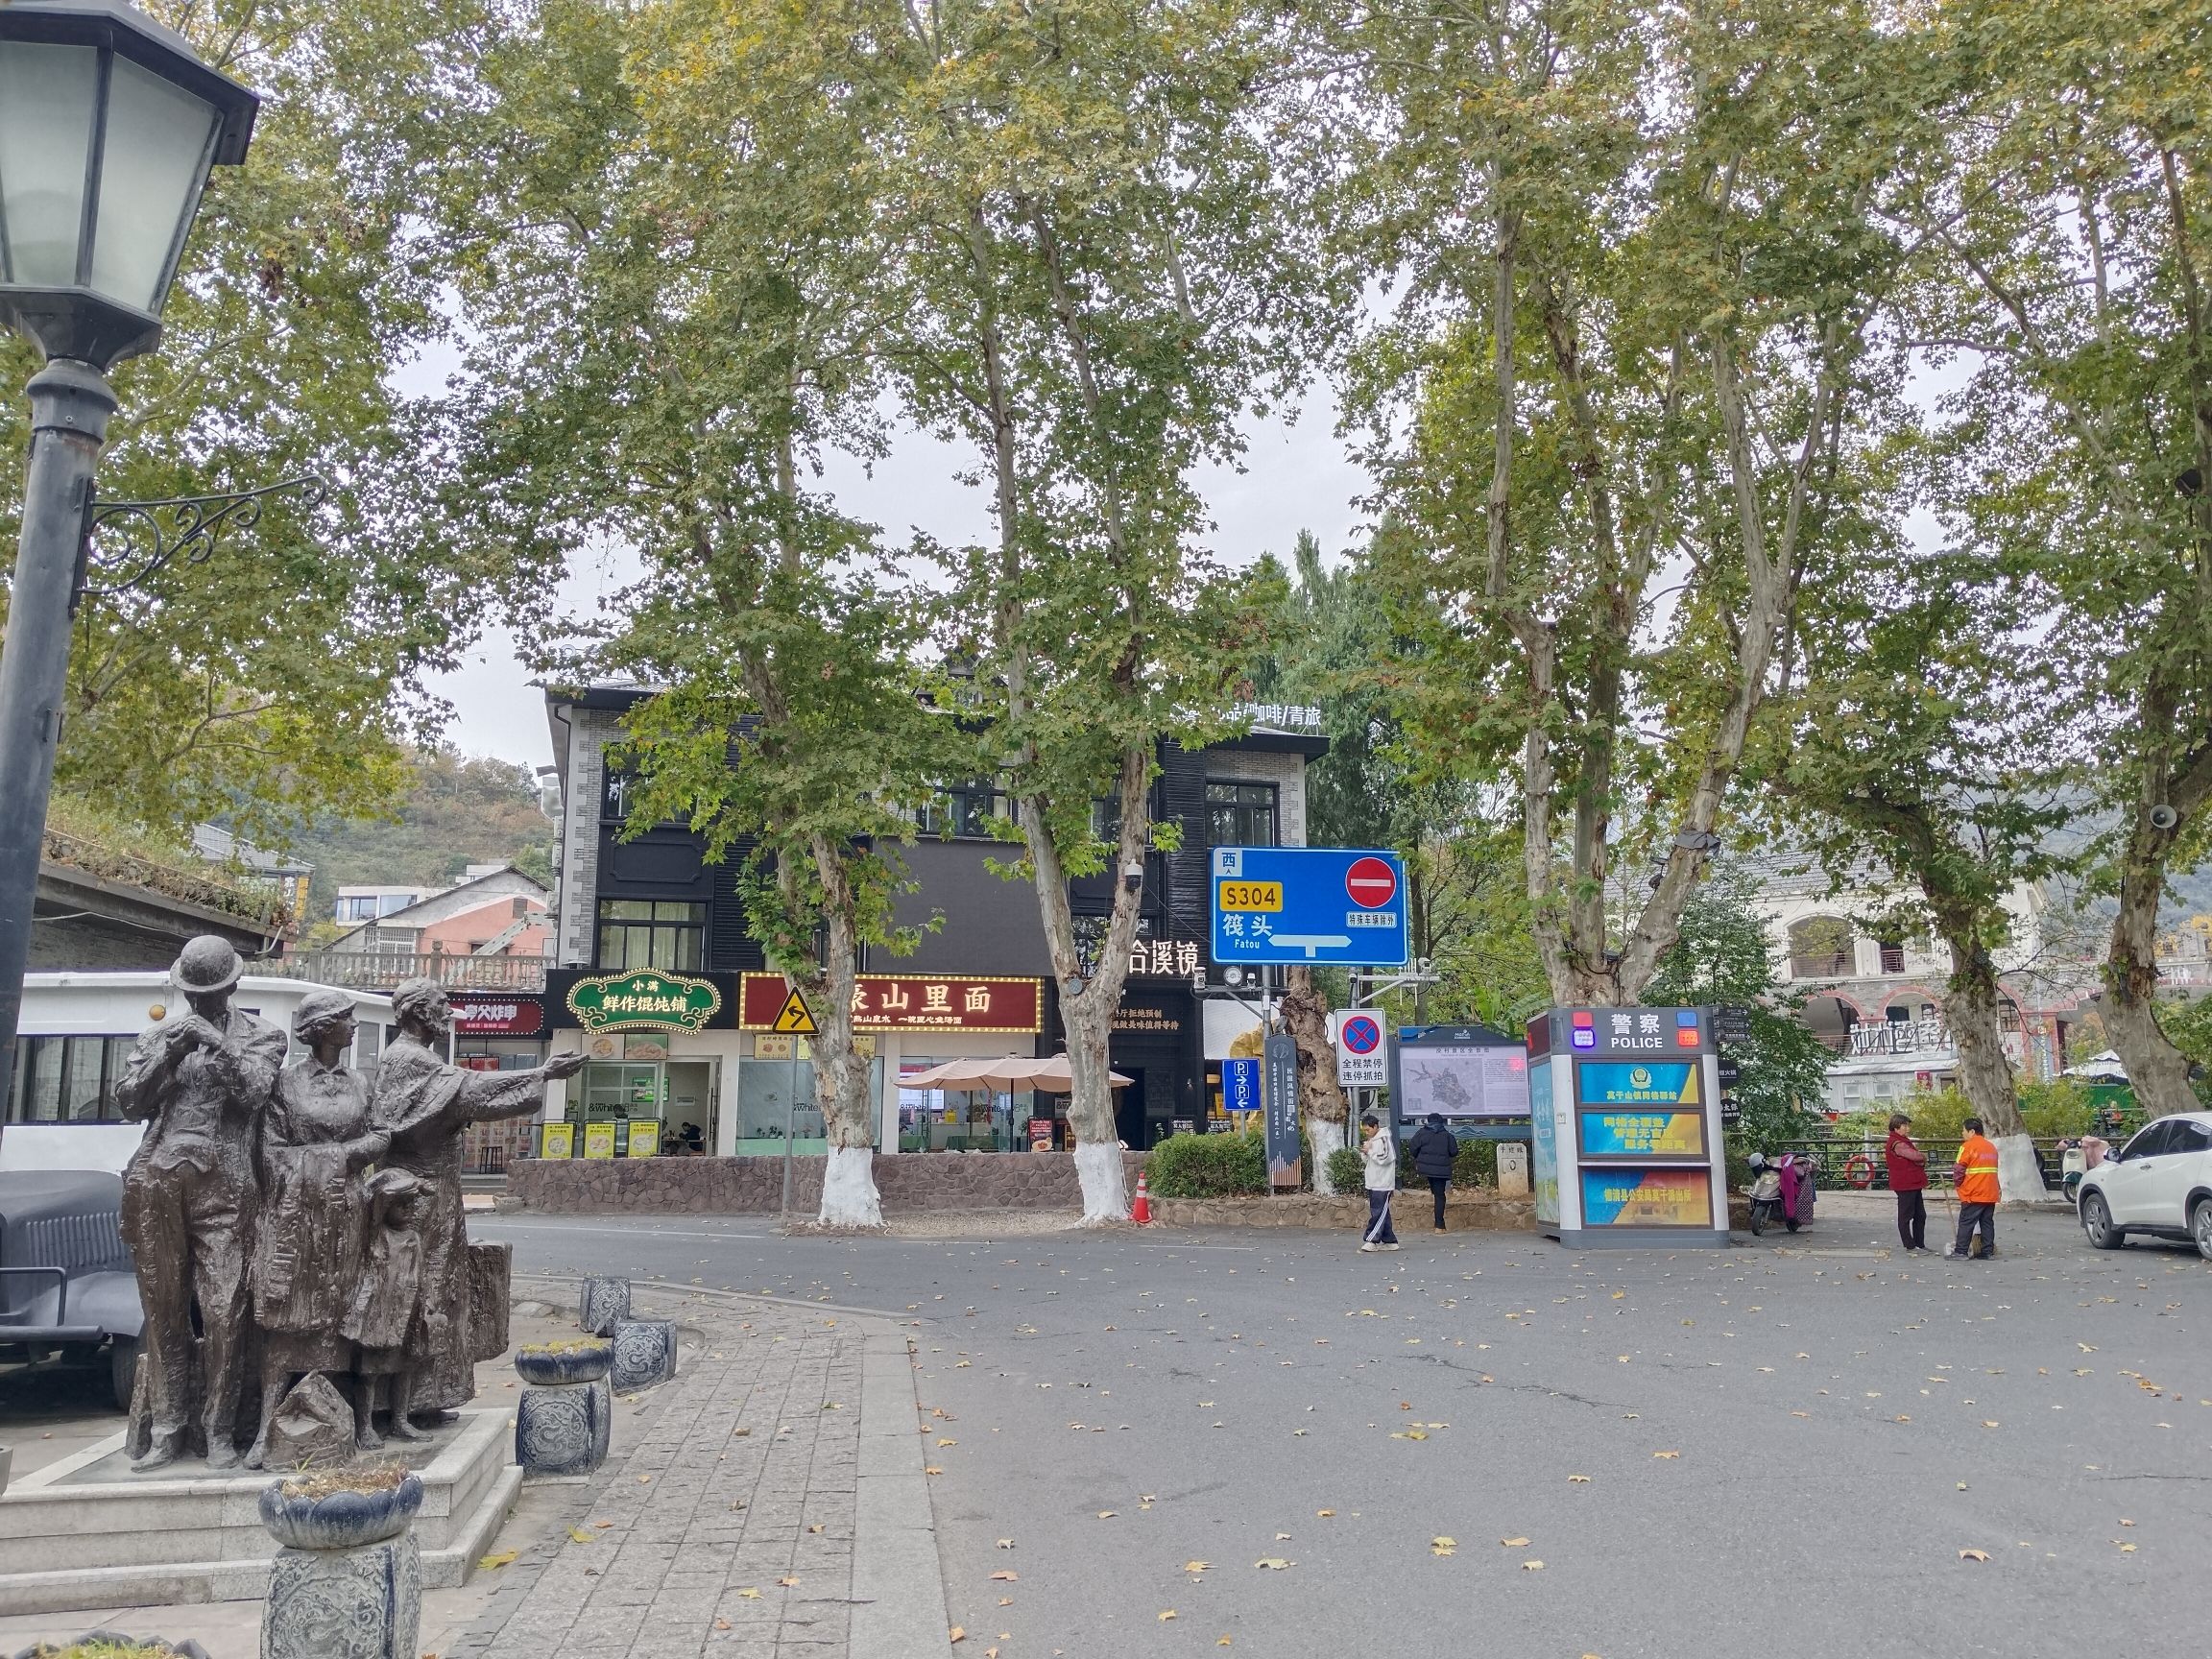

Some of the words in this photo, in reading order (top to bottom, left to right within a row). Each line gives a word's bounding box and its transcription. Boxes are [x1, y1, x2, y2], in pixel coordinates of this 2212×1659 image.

[1221, 853, 1237, 867] 西
[1227, 887, 1276, 906] S304
[1222, 913, 1273, 937] 筏头
[1349, 913, 1394, 926] 特殊车辆除外
[1234, 938, 1261, 949] Fatou
[632, 979, 660, 992] 小满
[602, 995, 687, 1013] 鲜作馄饨铺
[465, 1004, 517, 1022] 夸父炸串
[1116, 1008, 1163, 1019] 厅拒绝预制
[1611, 1014, 1660, 1034] 警察
[1611, 1037, 1664, 1048] POLICE
[1342, 1058, 1382, 1069] 全程禁停
[1342, 1070, 1383, 1081] 违停抓拍
